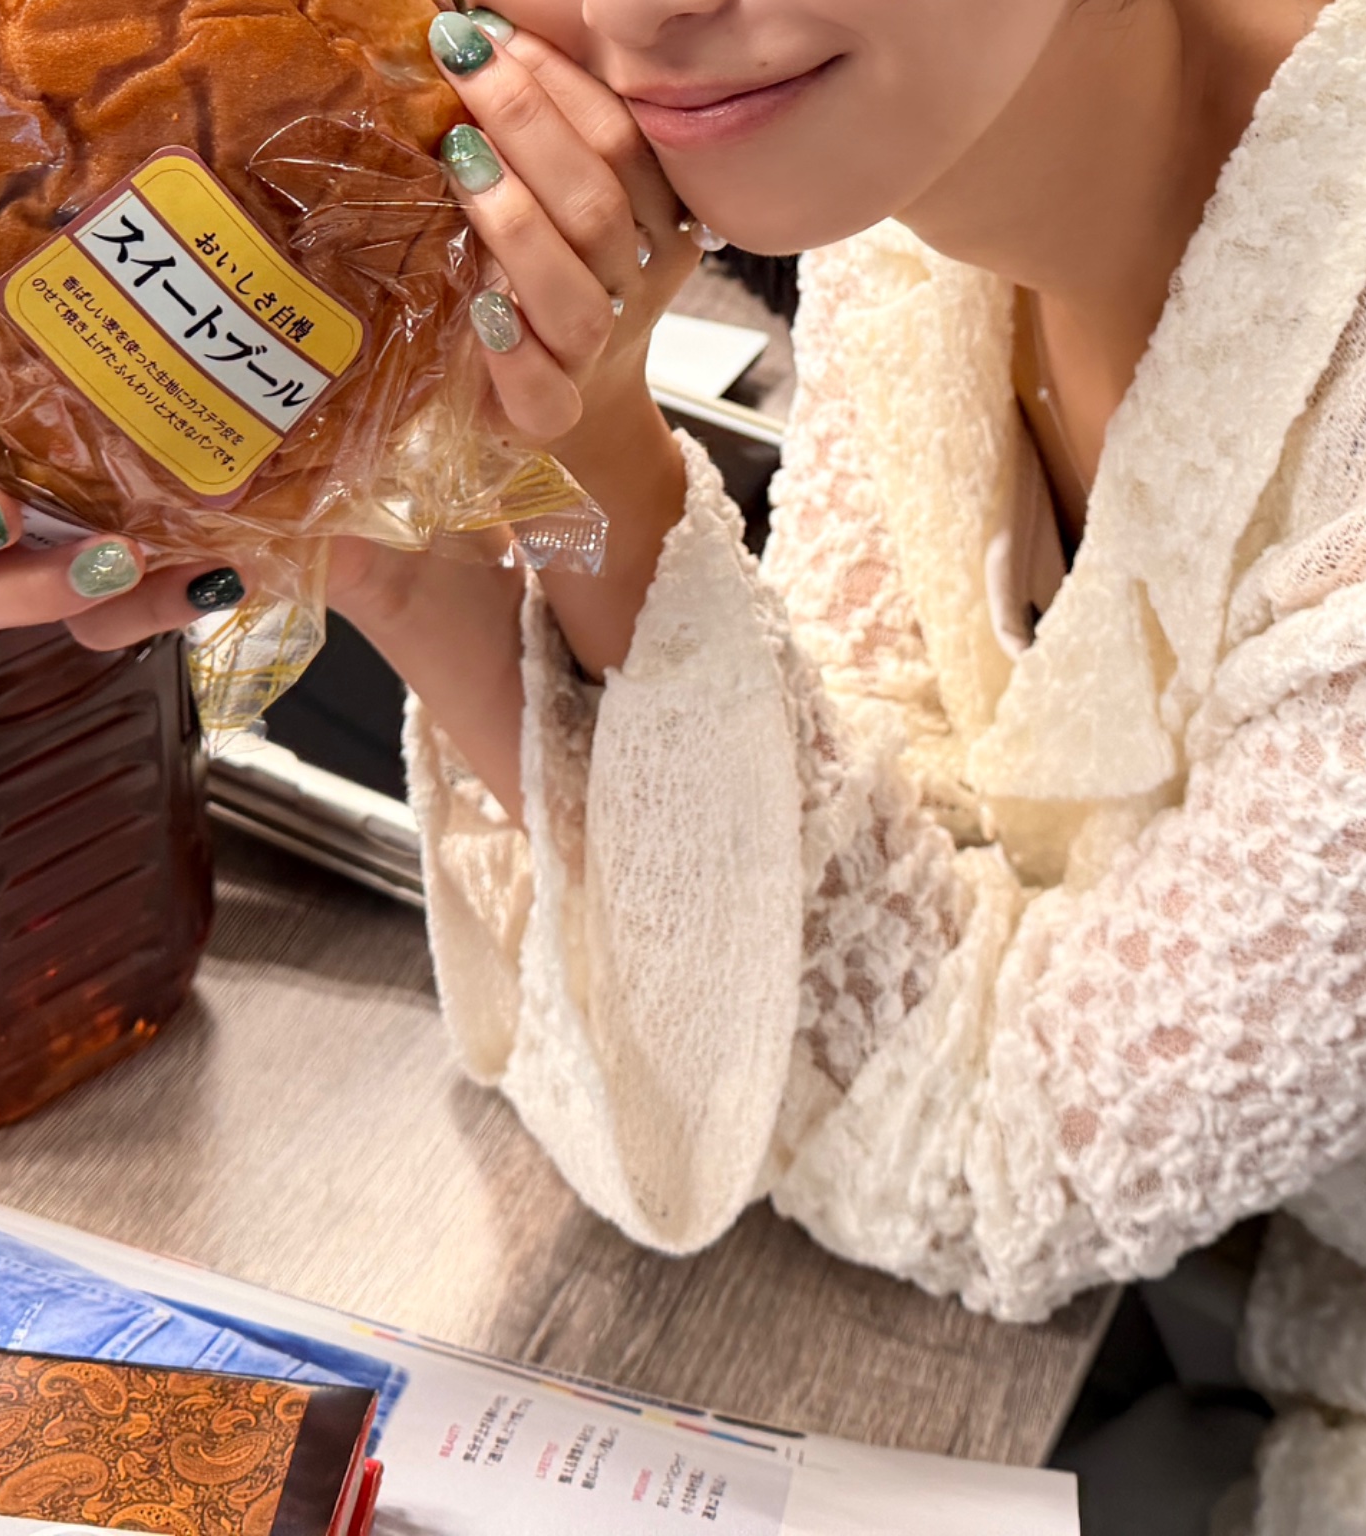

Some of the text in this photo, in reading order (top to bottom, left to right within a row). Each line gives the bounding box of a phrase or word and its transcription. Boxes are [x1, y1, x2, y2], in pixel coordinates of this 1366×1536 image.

[30, 276, 237, 474] のせて焼き上げたふんわりと大きなパンです。
[60, 274, 247, 447] 香ばしい麦を使った生地にカステラ皮を
[90, 213, 314, 410] スイートブール
[193, 230, 316, 345] おいしさ自慢
